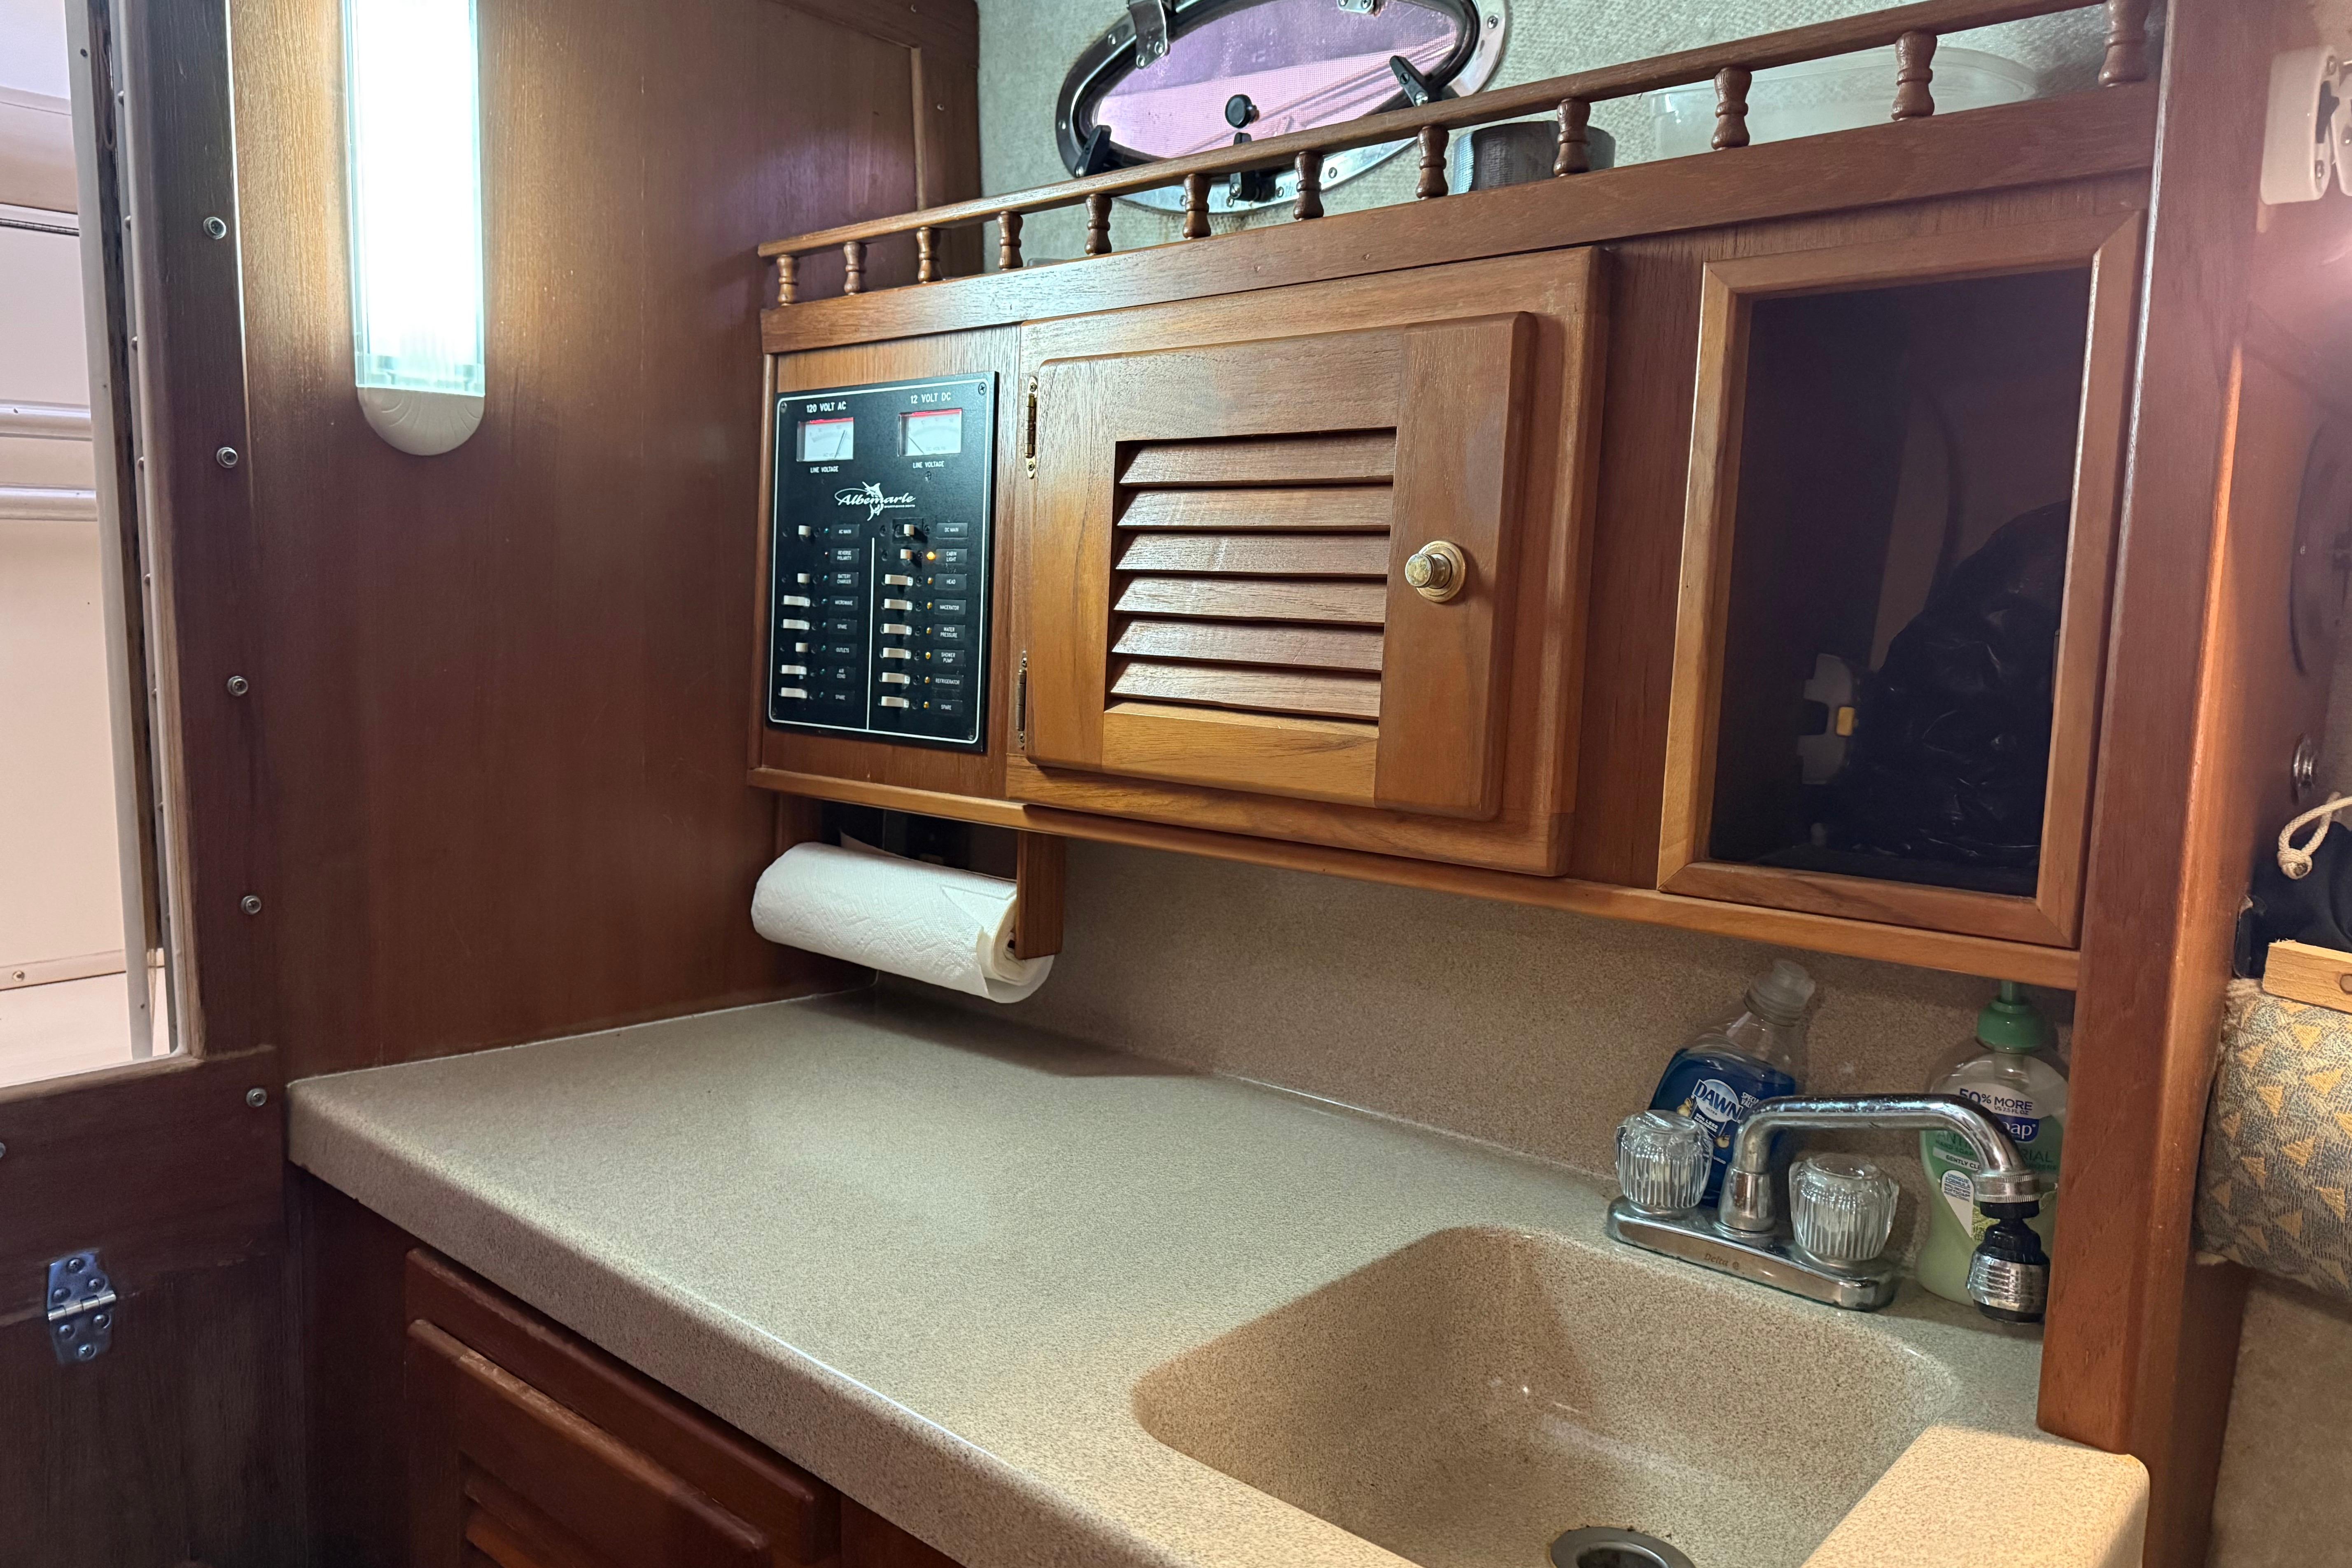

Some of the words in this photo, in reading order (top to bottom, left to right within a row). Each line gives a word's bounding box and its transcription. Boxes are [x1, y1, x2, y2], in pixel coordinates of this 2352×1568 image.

[910, 395, 918, 404] 12
[921, 393, 938, 403] VOLT
[941, 392, 951, 401] DC
[806, 404, 817, 413] 120
[819, 402, 835, 412] VOLT
[838, 401, 847, 410] AC
[838, 492, 916, 506] Albemarle
[1693, 1080, 1743, 1122] DAWN
[1741, 1092, 1760, 1104] SPECIA
[1741, 1098, 1753, 1108] VAL
[1994, 1096, 2033, 1111] MORE
[1946, 1155, 1968, 1166] GENTLY
[1704, 1253, 1729, 1267] Delta
